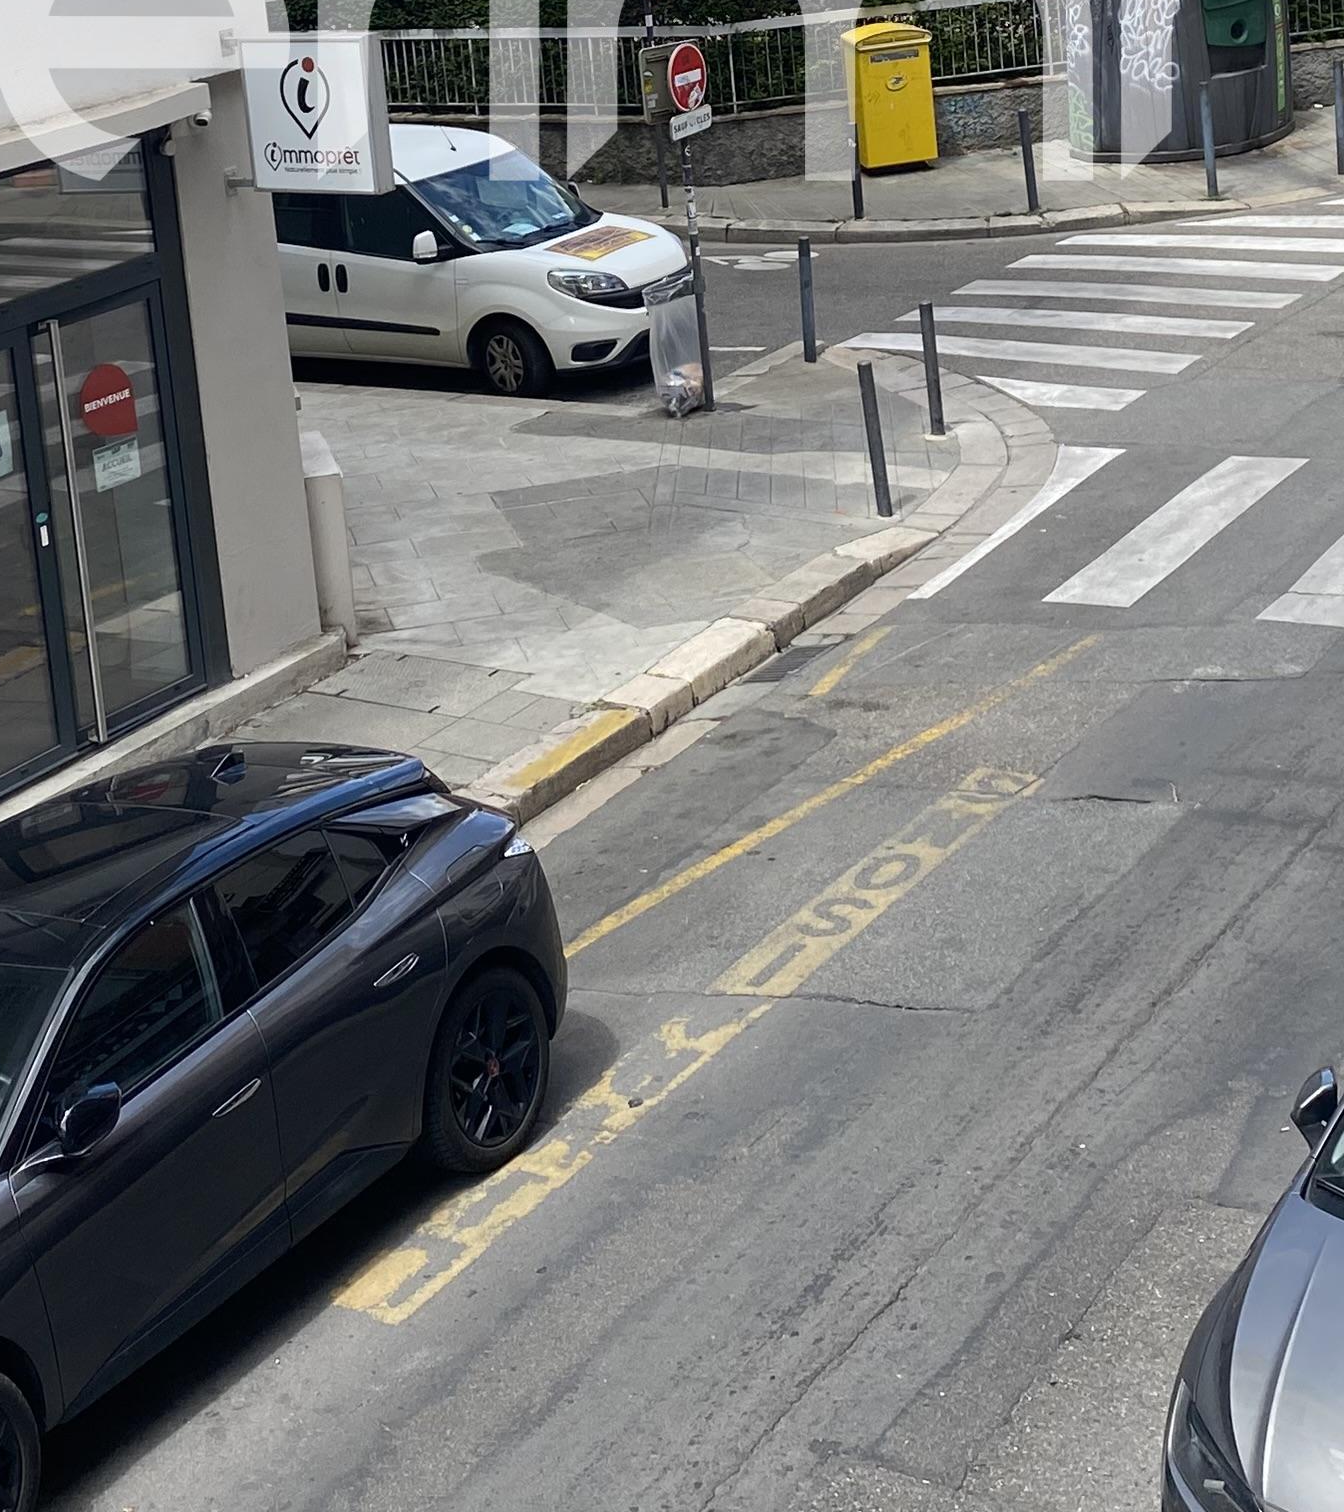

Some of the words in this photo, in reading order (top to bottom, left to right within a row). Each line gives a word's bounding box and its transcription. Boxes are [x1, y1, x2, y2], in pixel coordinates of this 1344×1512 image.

[673, 120, 688, 134] SAUF
[689, 112, 711, 128] CLES
[267, 142, 361, 168] immoprêt
[83, 388, 131, 414] BIENVENUE
